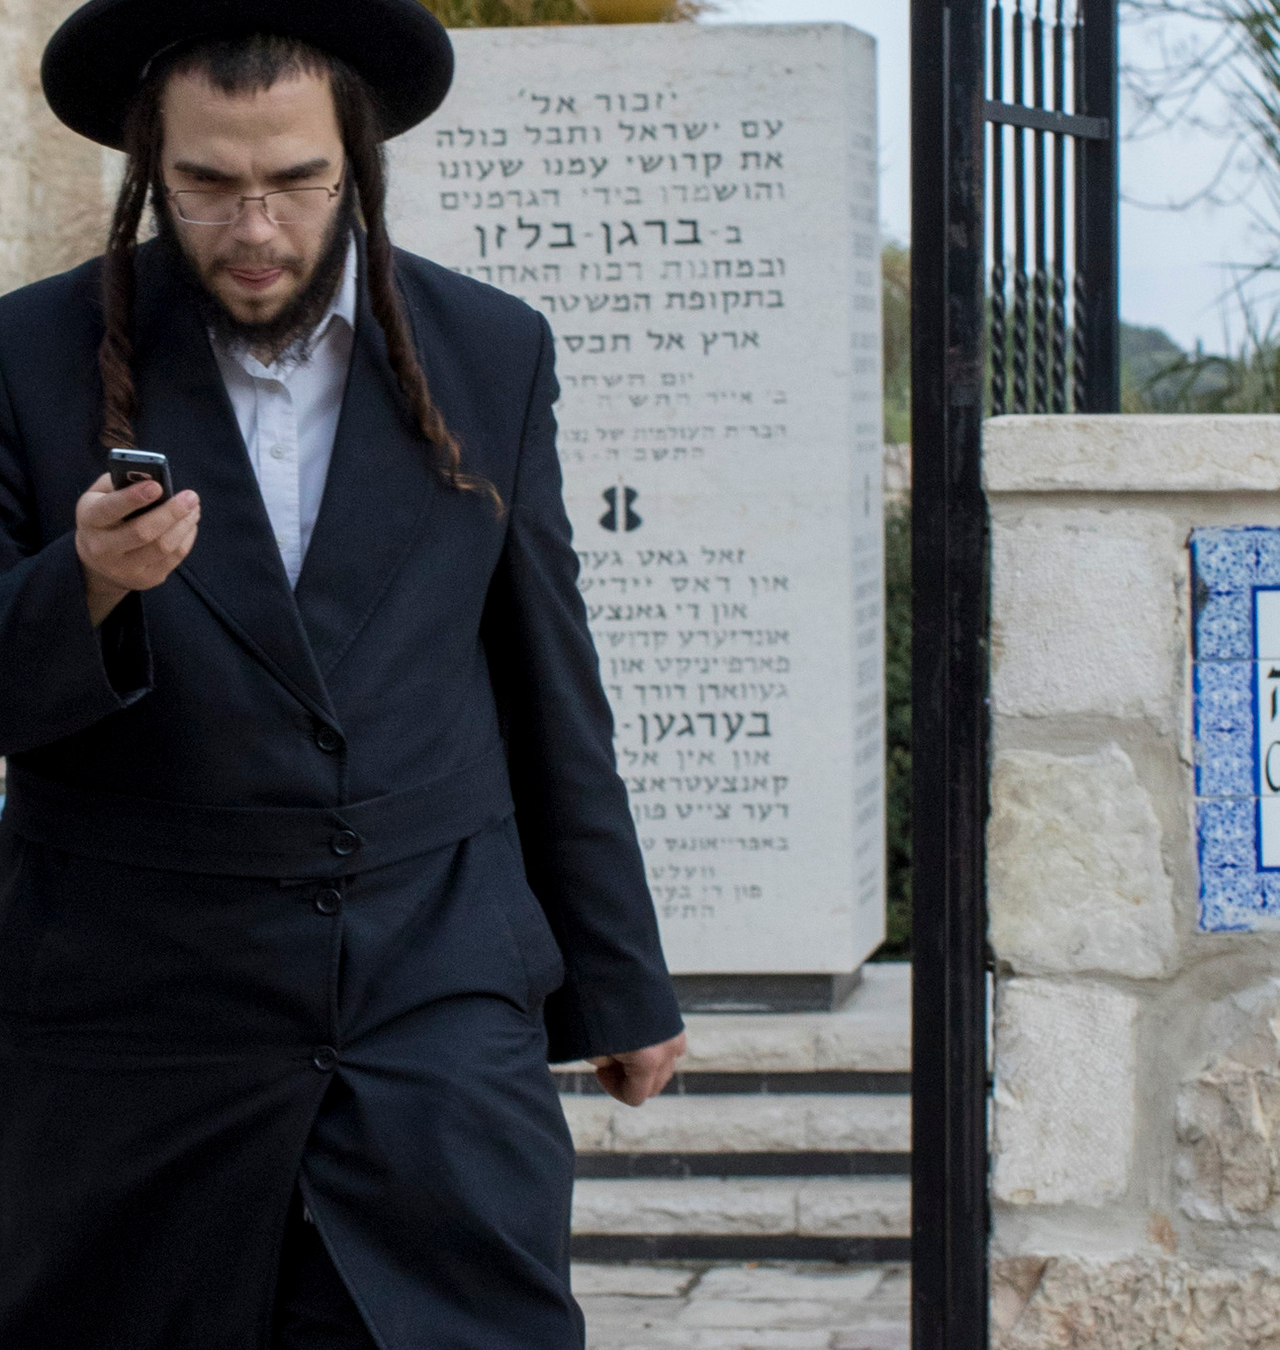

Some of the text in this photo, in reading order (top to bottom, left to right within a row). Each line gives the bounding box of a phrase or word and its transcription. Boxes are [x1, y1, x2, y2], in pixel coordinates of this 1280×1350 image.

[595, 92, 677, 112] יזכור
[436, 120, 784, 147] עם ישראל ותבל כולה
[438, 159, 524, 181] שעונו
[543, 157, 609, 179] עמנו
[741, 151, 783, 170] את
[440, 188, 560, 211] הגרמנים
[445, 263, 560, 284] האחרי
[661, 257, 785, 279] ובמחנות
[541, 290, 784, 314] בתקופת המשטר
[556, 330, 759, 356] ארץ אל תכס
[638, 550, 687, 566] גאט
[701, 547, 745, 564] זאל
[749, 576, 788, 598] און
[712, 603, 747, 625] און
[610, 658, 644, 679] און
[676, 750, 714, 770] אין
[732, 750, 770, 769] און
